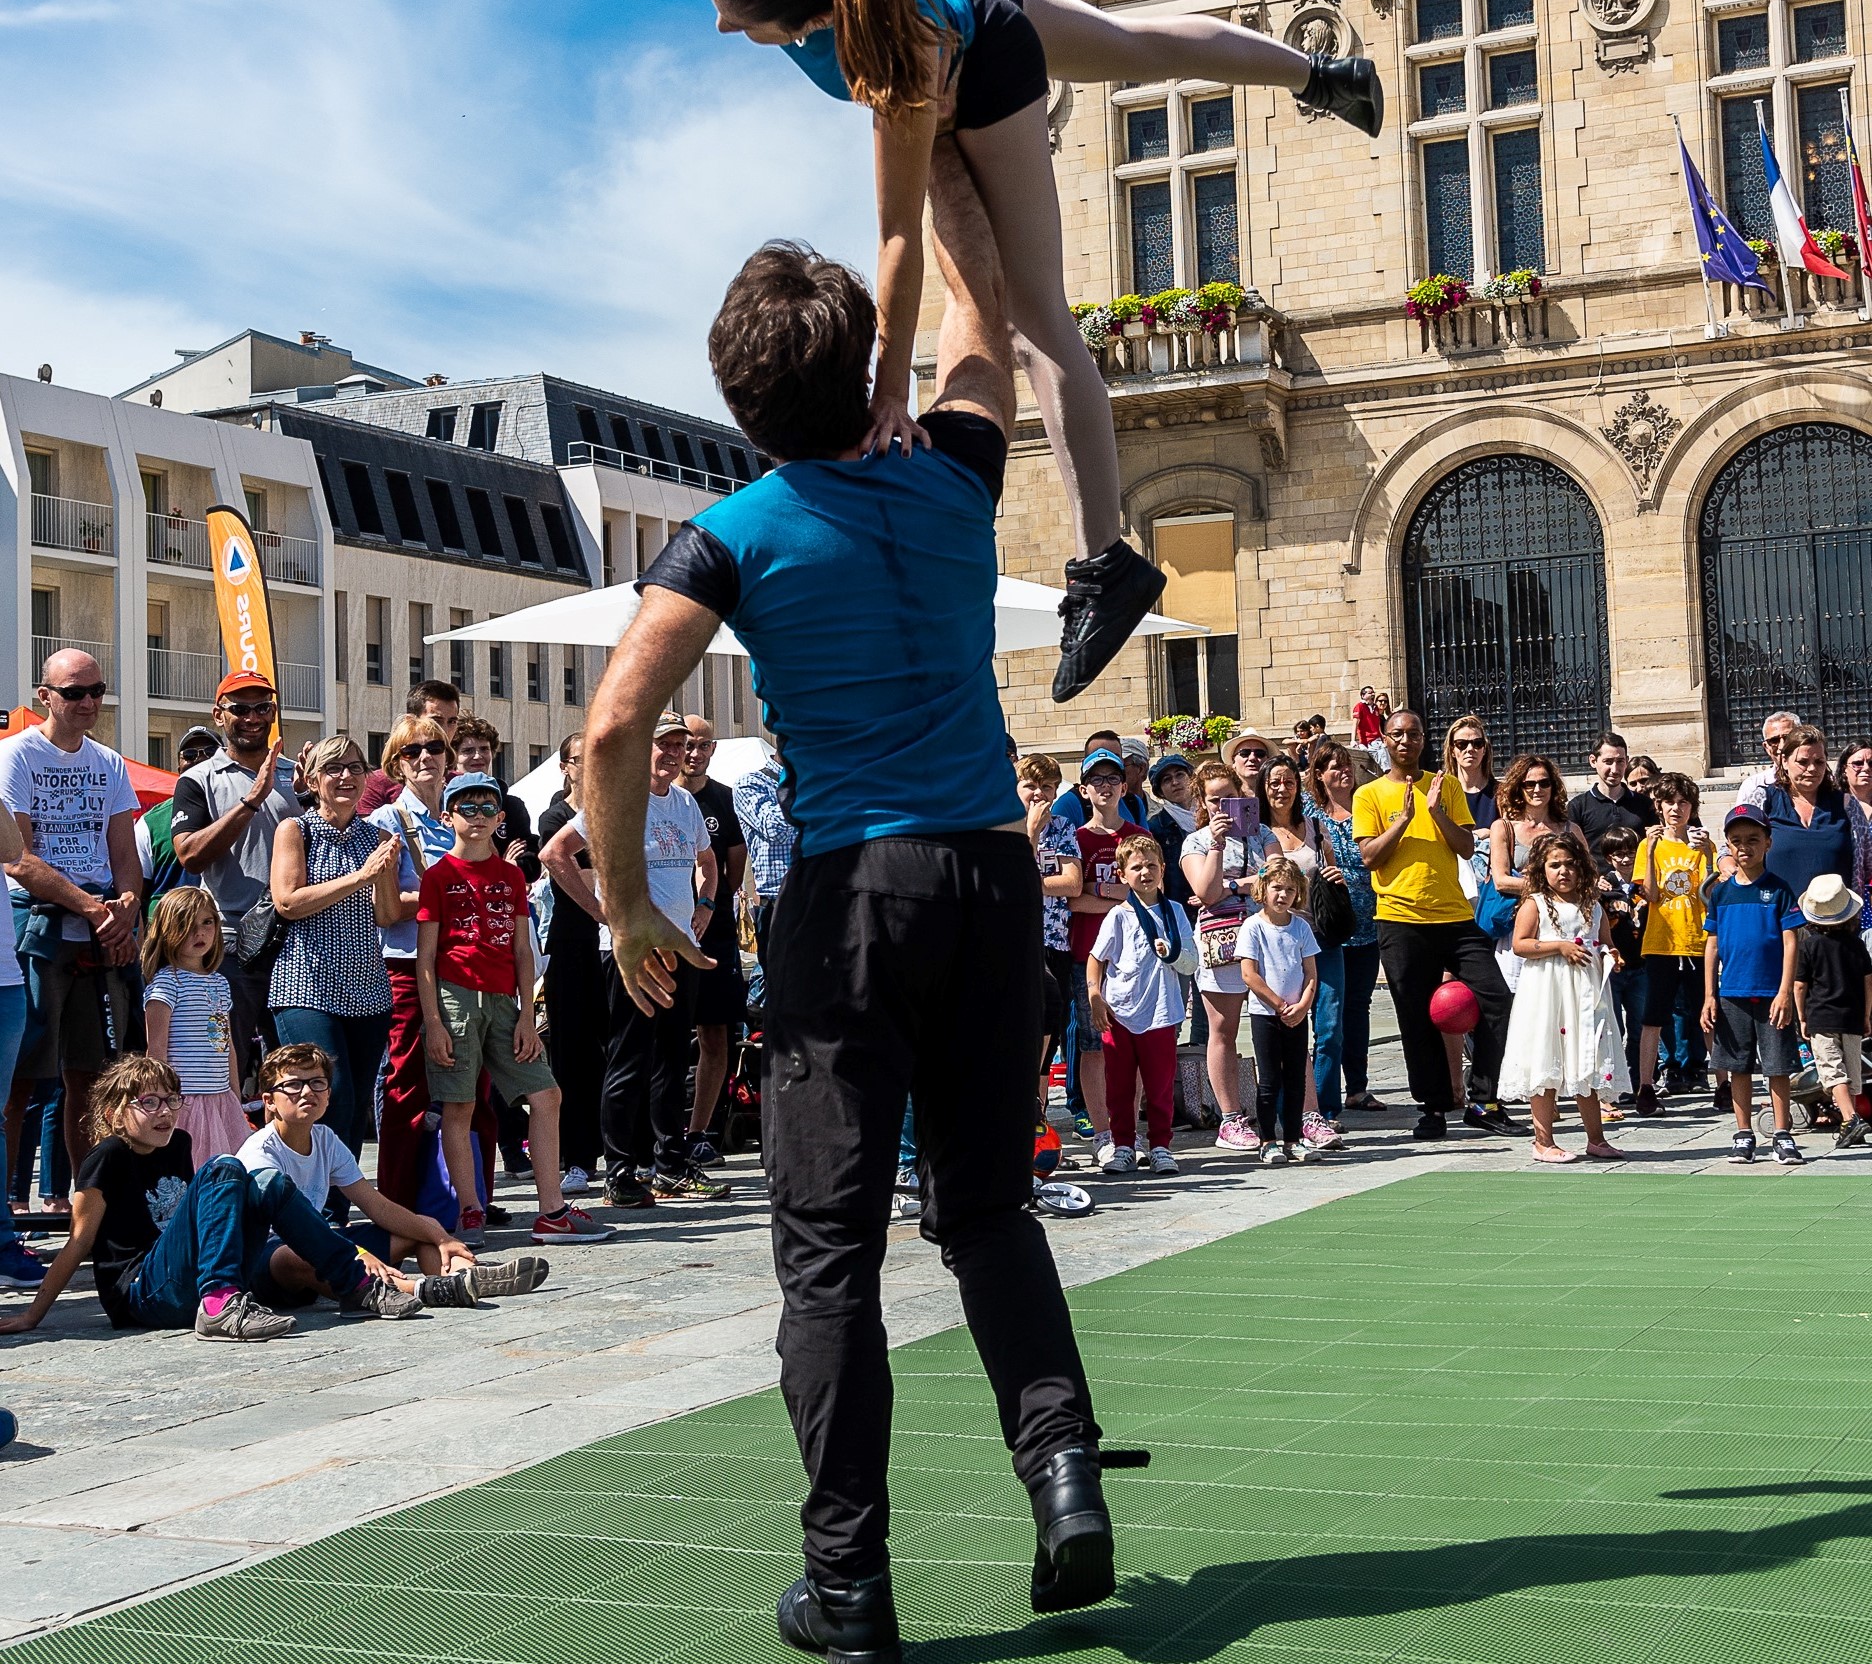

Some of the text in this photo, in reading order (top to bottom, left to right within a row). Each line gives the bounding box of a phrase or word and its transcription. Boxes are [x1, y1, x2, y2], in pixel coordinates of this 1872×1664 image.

[43, 765, 91, 774] THUNDER RALLY
[60, 788, 75, 796] RUN
[79, 796, 105, 811] JULY
[48, 822, 87, 833] ANNUAL
[58, 837, 79, 845] PBR
[51, 846, 89, 856] RODEO
